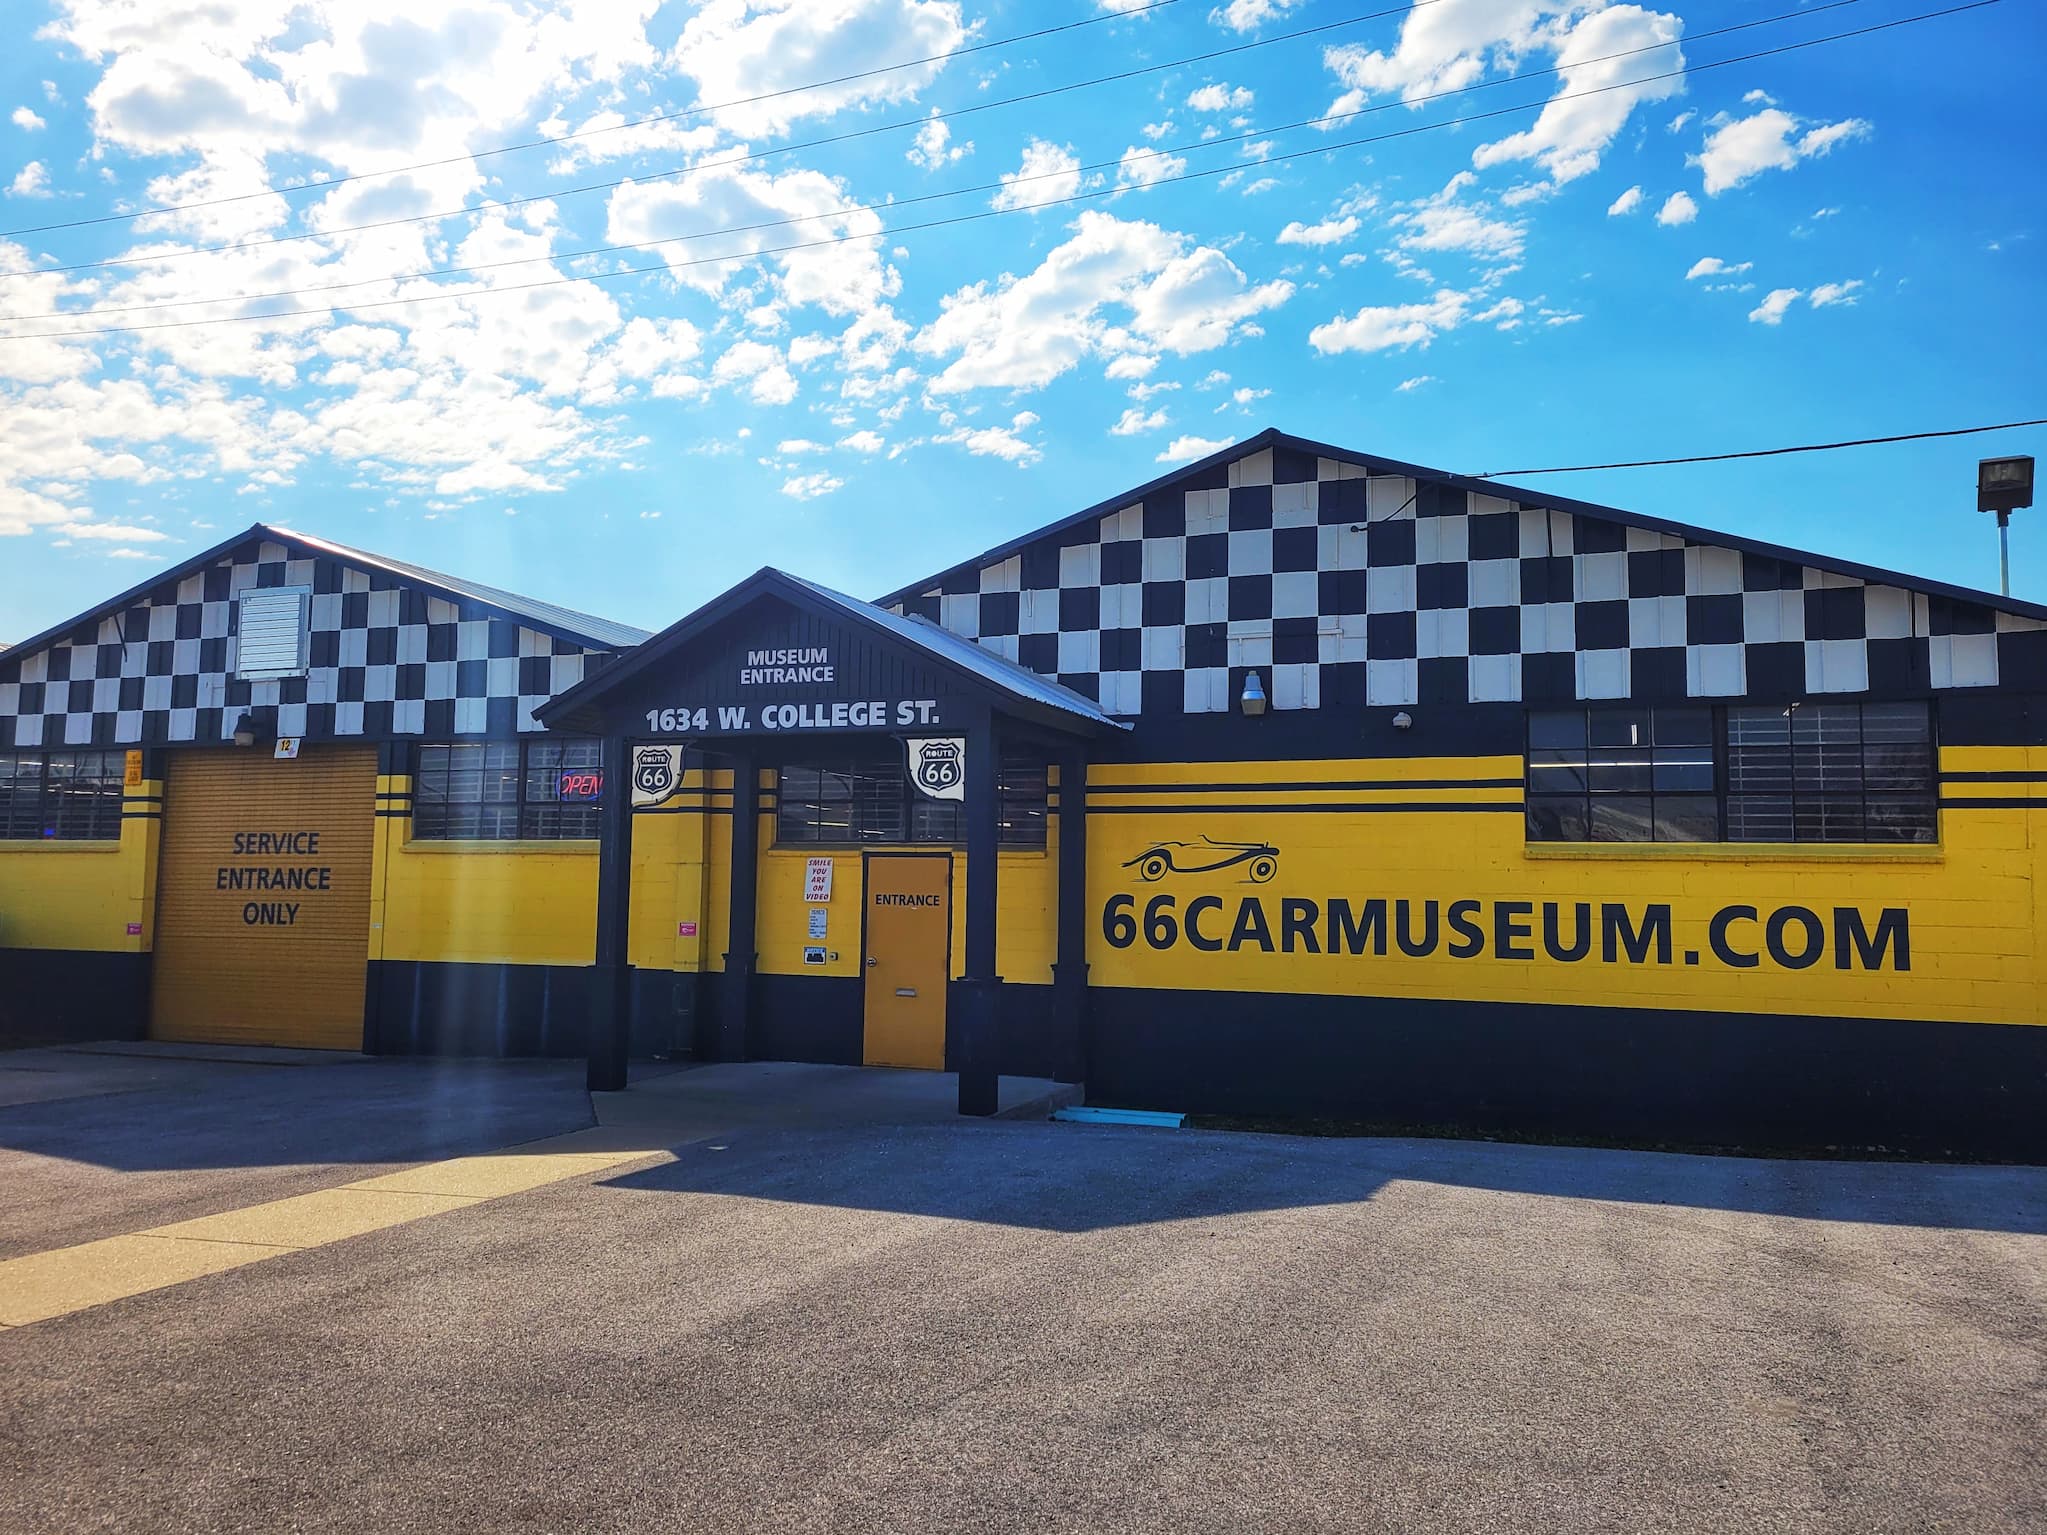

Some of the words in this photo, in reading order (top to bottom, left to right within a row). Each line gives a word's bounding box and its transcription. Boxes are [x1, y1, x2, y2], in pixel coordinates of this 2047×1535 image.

[748, 647, 828, 666] MUSEUM
[741, 666, 834, 685] ENTRANCE
[646, 707, 709, 732] 1634
[718, 706, 751, 730] W.
[761, 701, 887, 729] COLLEGE
[897, 700, 940, 725] ST.
[642, 755, 666, 763] ROUTE
[925, 749, 953, 758] ROUTE
[642, 768, 666, 787] 66
[926, 763, 953, 783] 66
[559, 775, 604, 795] OPEN
[233, 832, 320, 855] SERVICE
[216, 867, 331, 890] ENTRANCE
[875, 894, 940, 906] ENTRANCE
[243, 902, 300, 925] ONLY
[1102, 893, 1911, 971] 66CARMUSEUM.COM
